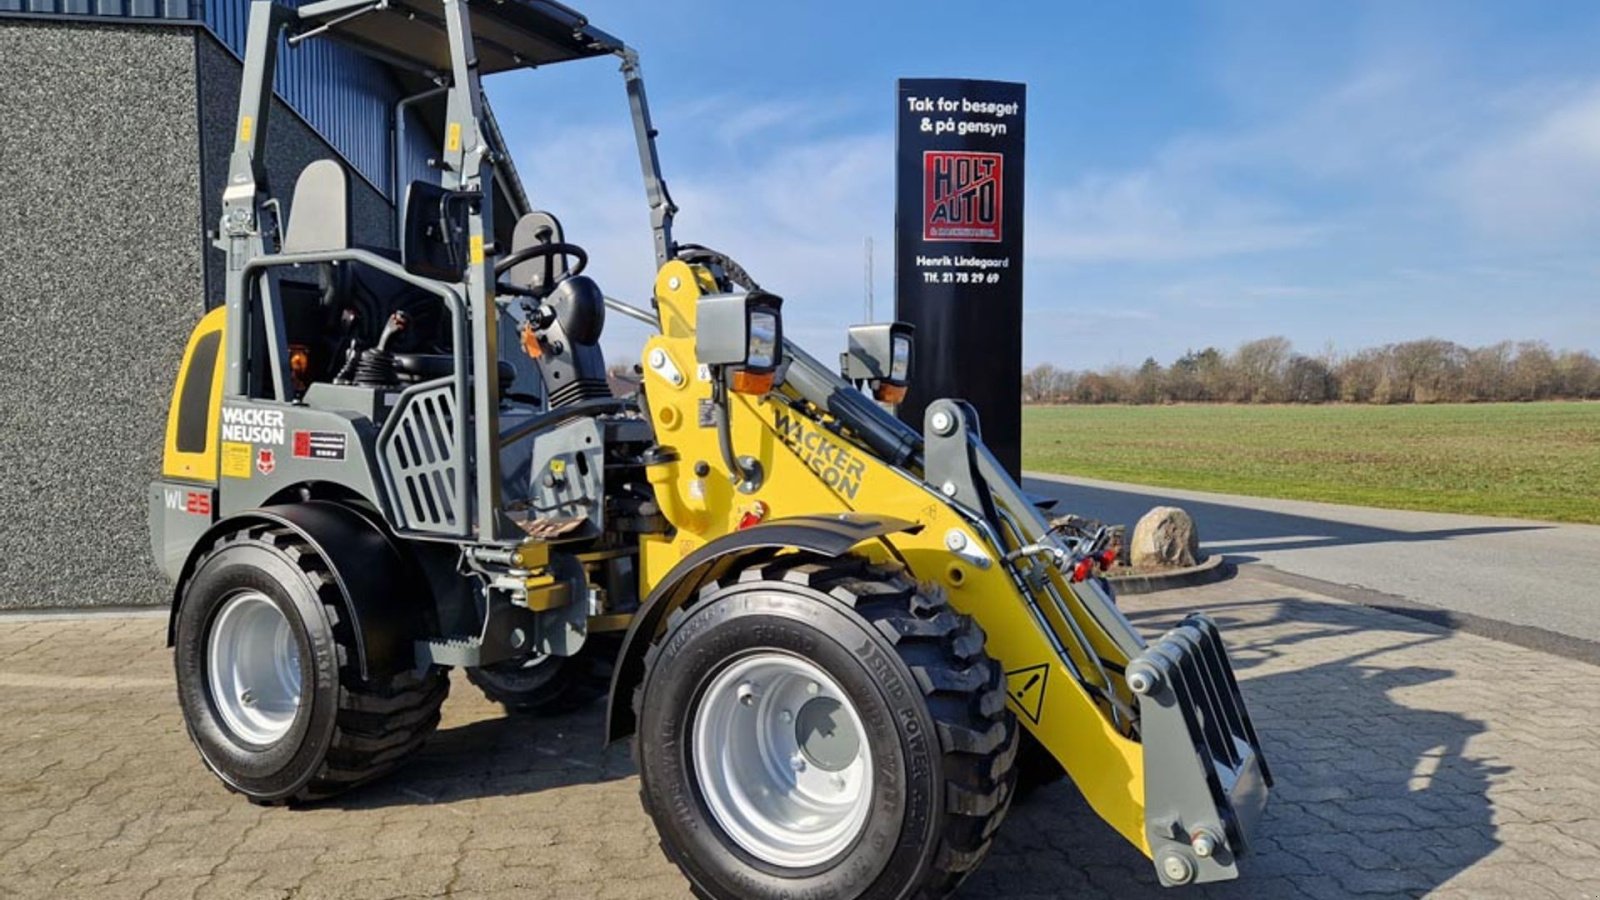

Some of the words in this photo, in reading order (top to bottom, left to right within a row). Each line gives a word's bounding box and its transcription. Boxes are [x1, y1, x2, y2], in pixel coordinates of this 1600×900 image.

[907, 96, 935, 112] Tak
[937, 96, 960, 112] for
[962, 97, 1019, 117] besøget
[920, 117, 933, 132] &
[935, 117, 956, 136] på
[957, 121, 1008, 137] gensyn
[933, 156, 997, 203] HOLT
[930, 178, 997, 225] AUTO
[916, 255, 952, 267] Henrik
[954, 255, 1010, 270] Lindegaard
[942, 272, 954, 284] 21
[955, 272, 969, 284] 78
[970, 273, 985, 284] 29
[986, 273, 1000, 284] 69
[222, 407, 285, 428] WACKER
[222, 425, 285, 445] NEUSON
[774, 408, 866, 482] WACKER
